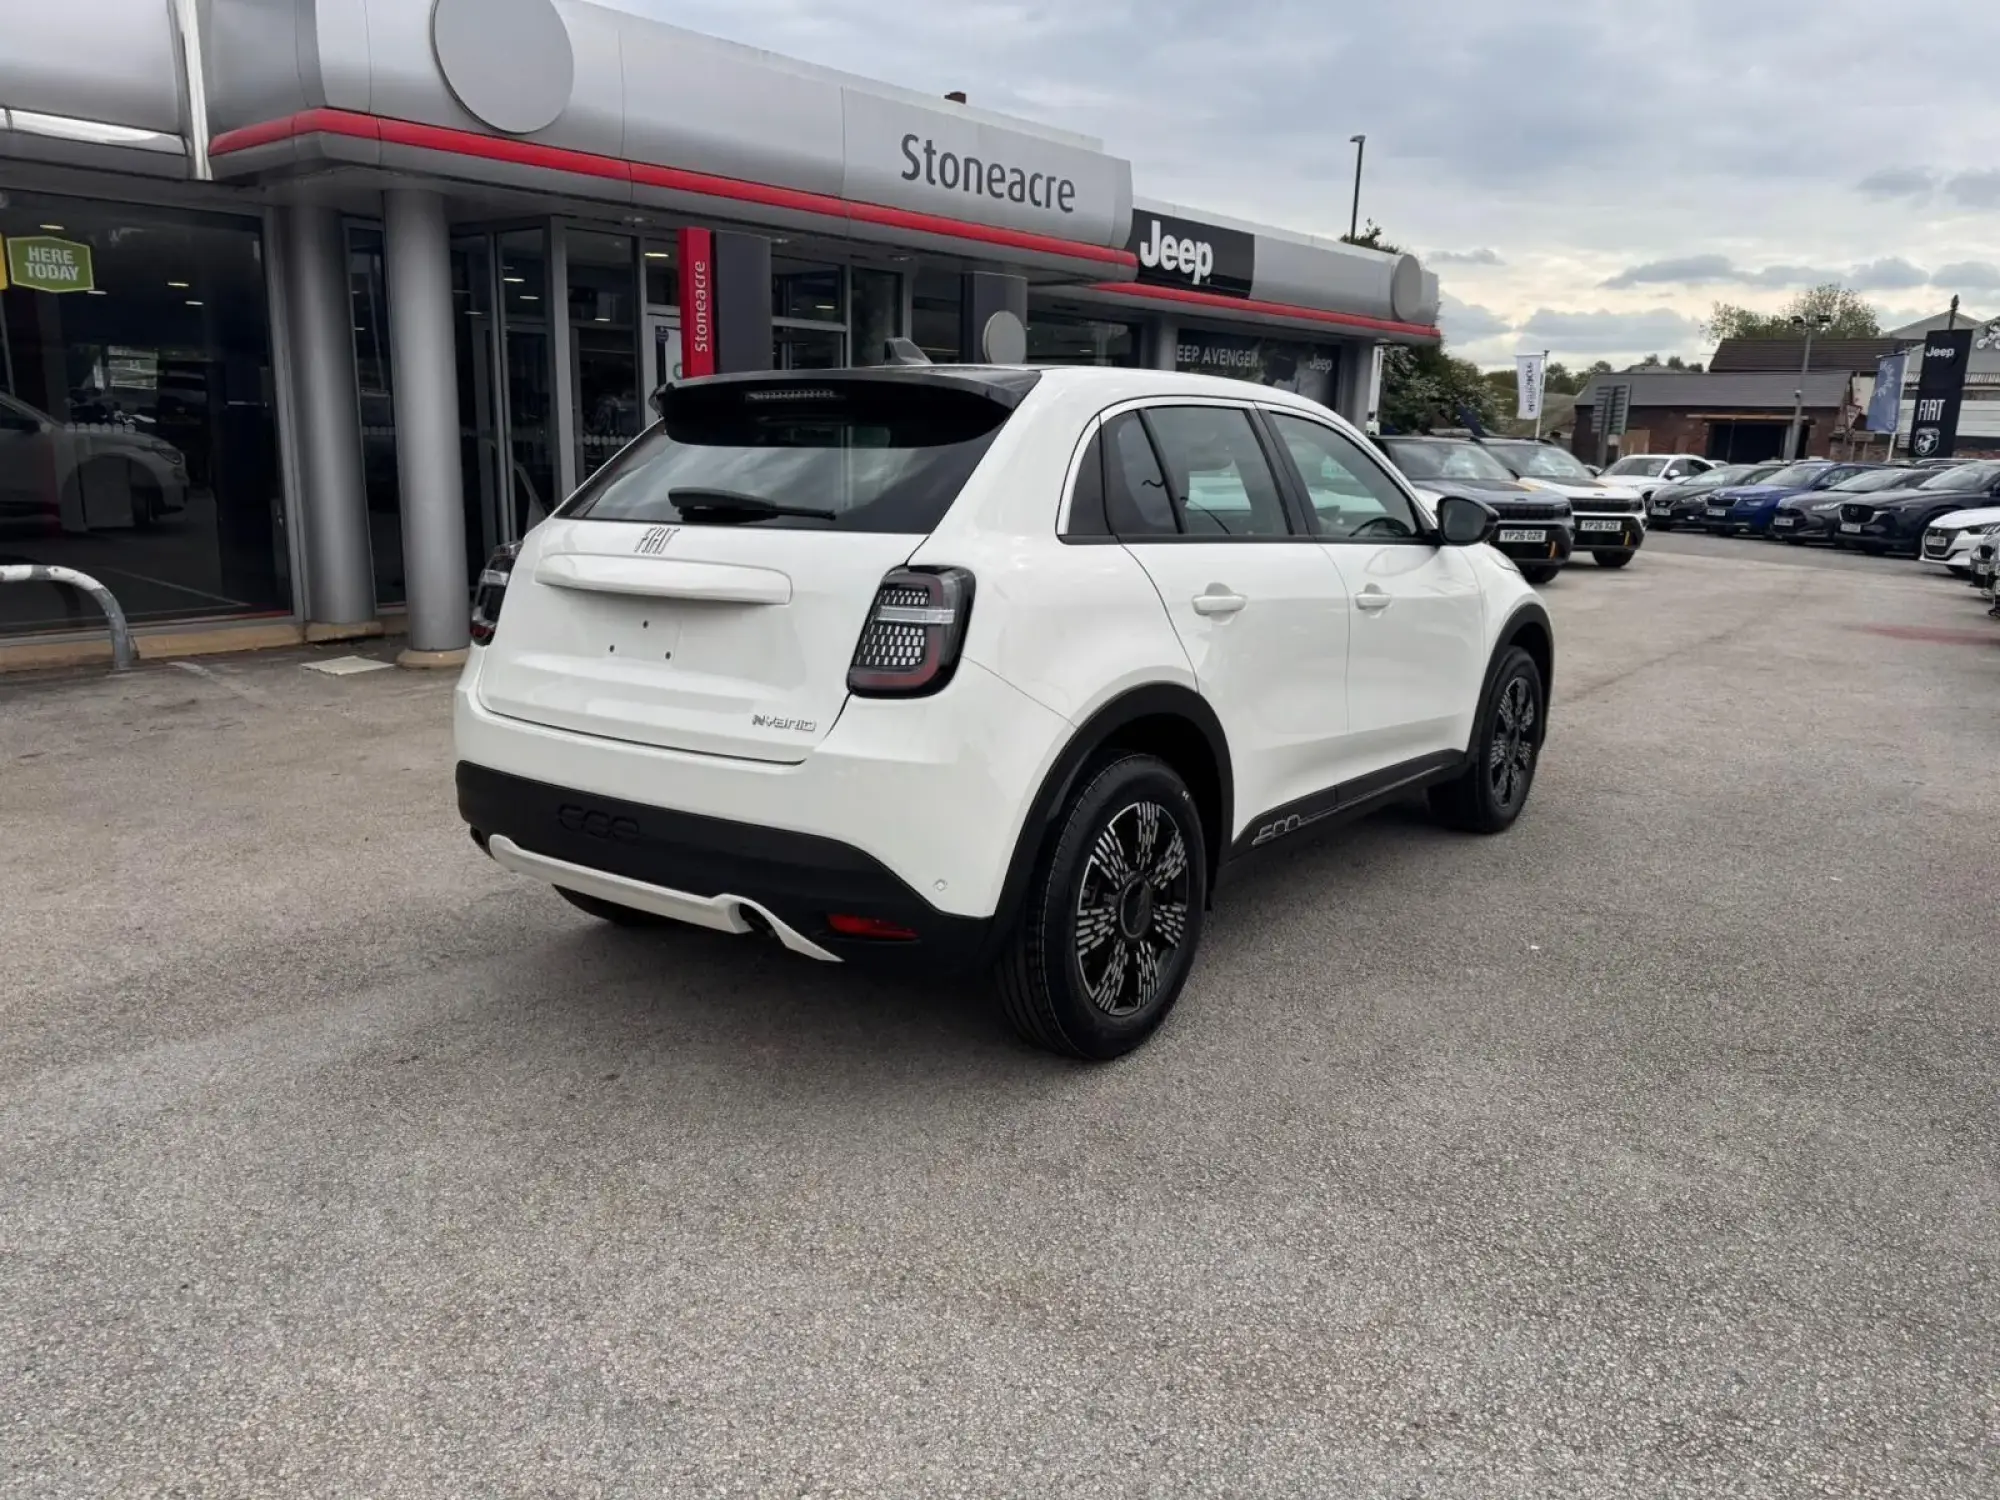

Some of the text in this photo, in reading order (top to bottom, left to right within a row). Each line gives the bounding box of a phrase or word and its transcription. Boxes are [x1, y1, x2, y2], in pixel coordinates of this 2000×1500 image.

[901, 133, 1076, 213] Stoneacre
[28, 245, 75, 265] HERE
[1140, 219, 1214, 285] Jeep
[24, 261, 80, 281] TODAY
[694, 260, 708, 353] Stoneacre
[1176, 345, 1260, 368] EEP AVENGER
[1309, 352, 1333, 374] Jeep
[1925, 346, 1955, 358] Jeep
[1918, 399, 1946, 421] FIAT
[633, 526, 681, 555] FIAT
